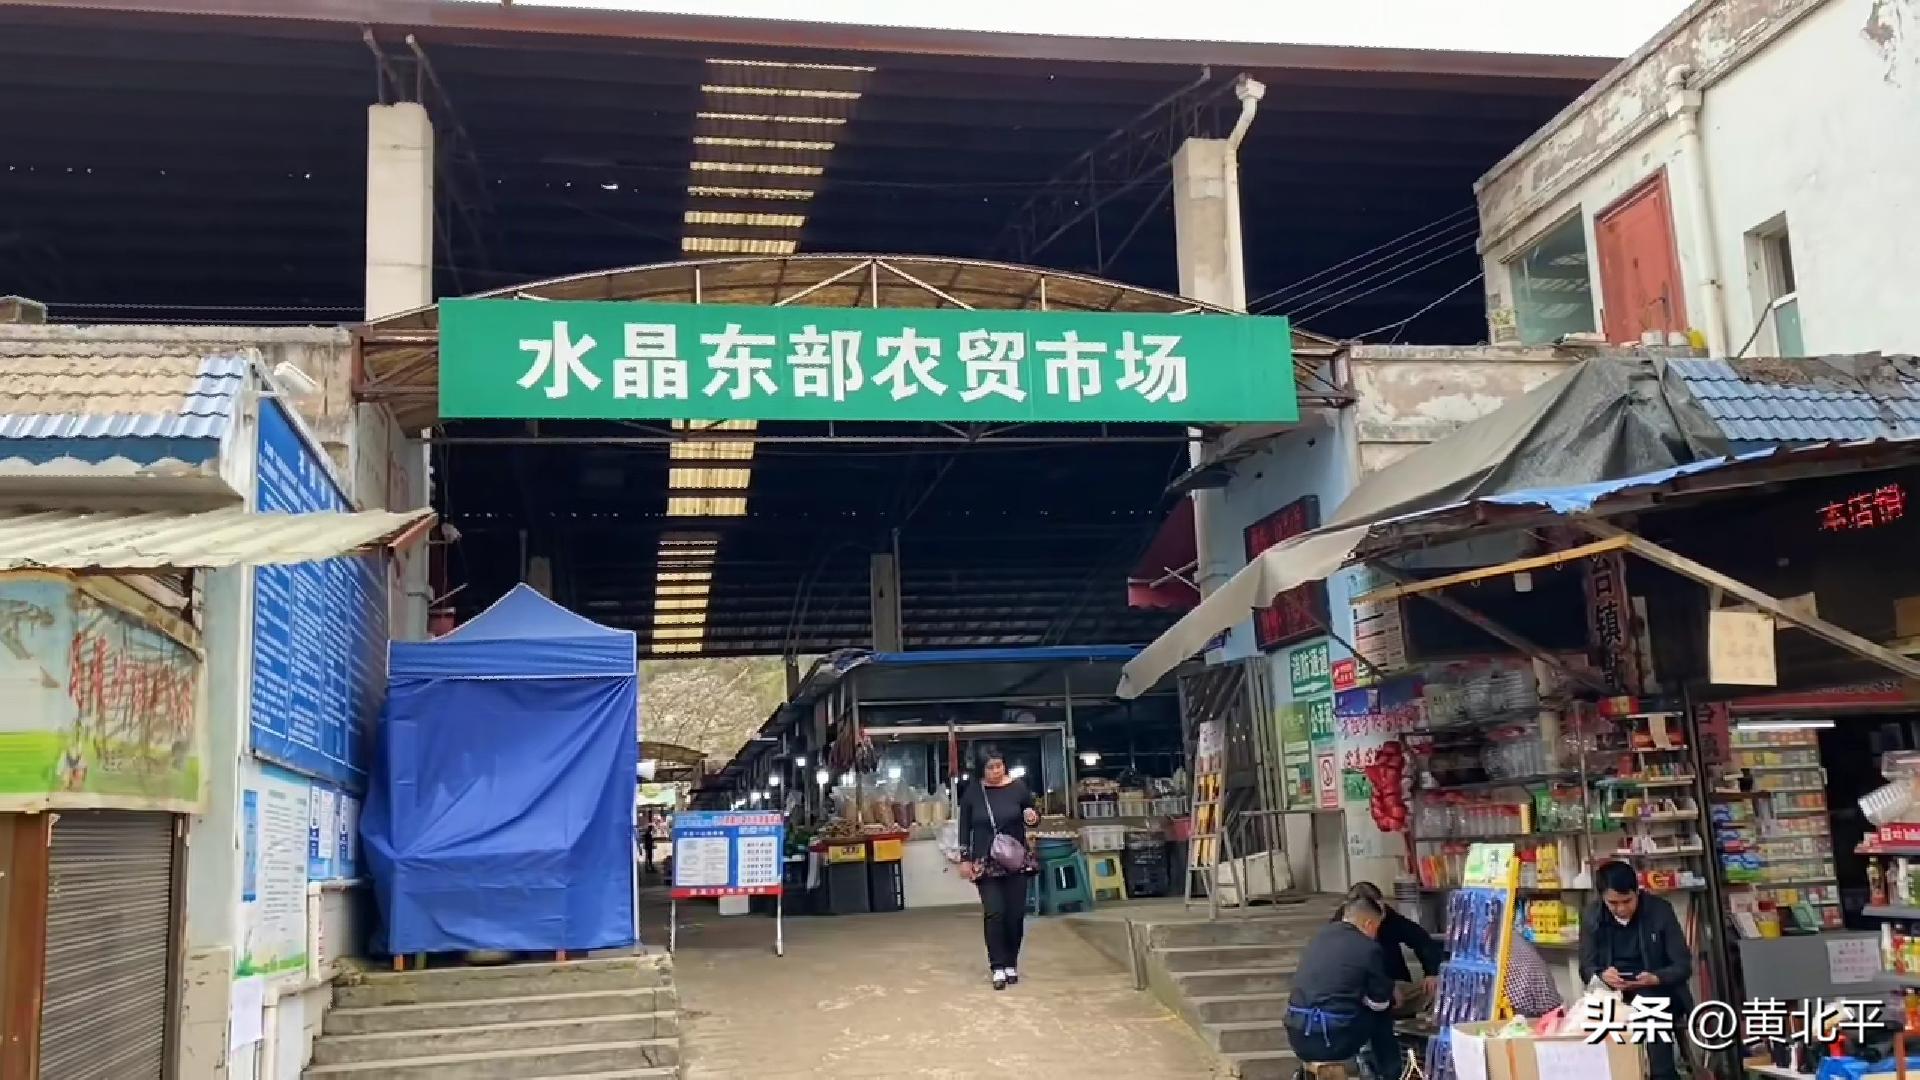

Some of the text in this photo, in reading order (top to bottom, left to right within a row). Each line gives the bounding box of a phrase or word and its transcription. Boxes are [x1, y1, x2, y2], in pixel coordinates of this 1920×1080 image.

[517, 320, 1189, 403] 水晶东部农贸市场
